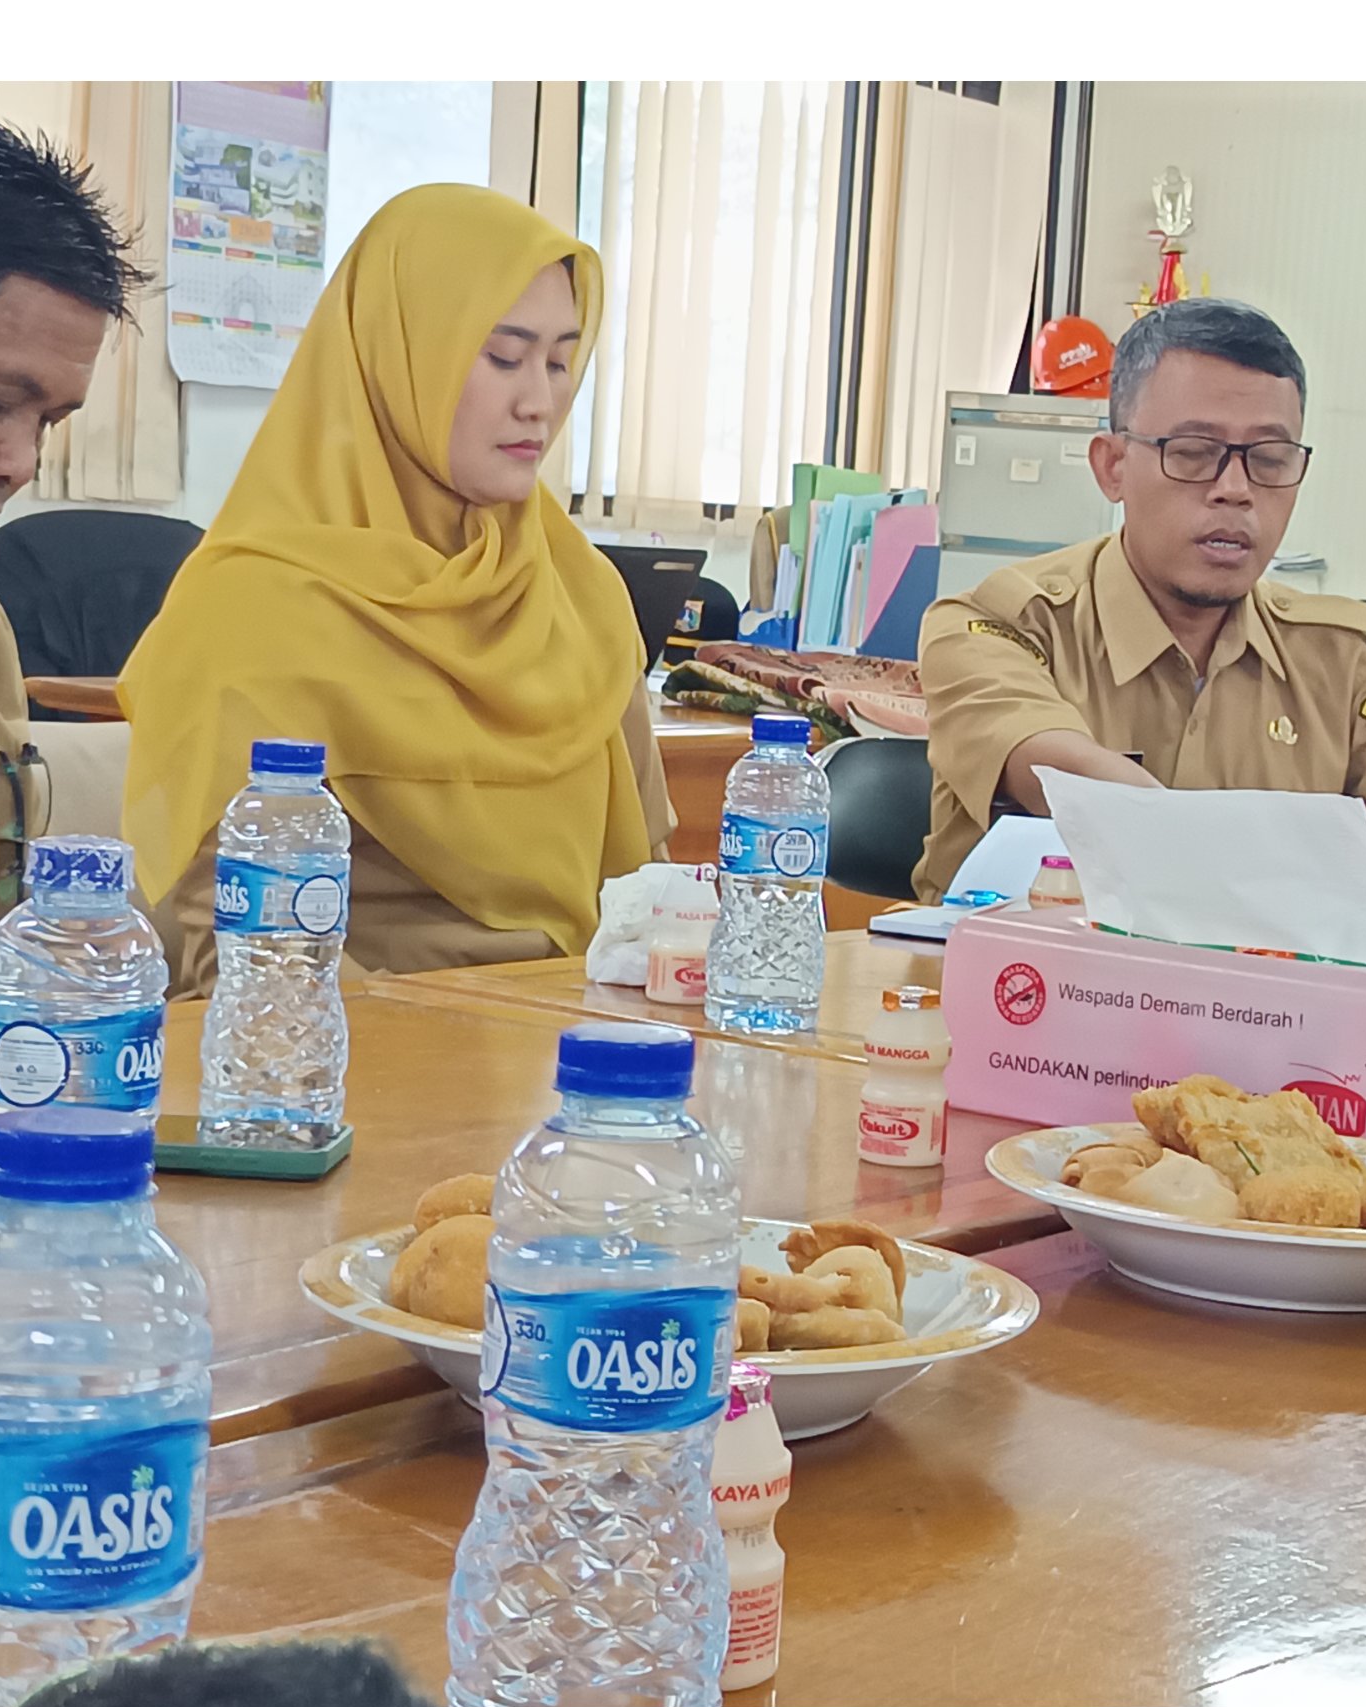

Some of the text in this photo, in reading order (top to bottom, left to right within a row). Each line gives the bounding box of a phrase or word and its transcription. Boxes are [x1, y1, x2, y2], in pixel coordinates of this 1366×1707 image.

[1058, 982, 1134, 1010] Waspada
[1140, 993, 1206, 1018] Demam
[1212, 1001, 1293, 1029] Berdarah
[877, 1046, 930, 1060] MANGGA
[989, 1051, 1089, 1081] GANDAKAN
[514, 1318, 547, 1343] 330
[566, 1336, 697, 1396] OASIS
[9, 1484, 174, 1562] OASIS
